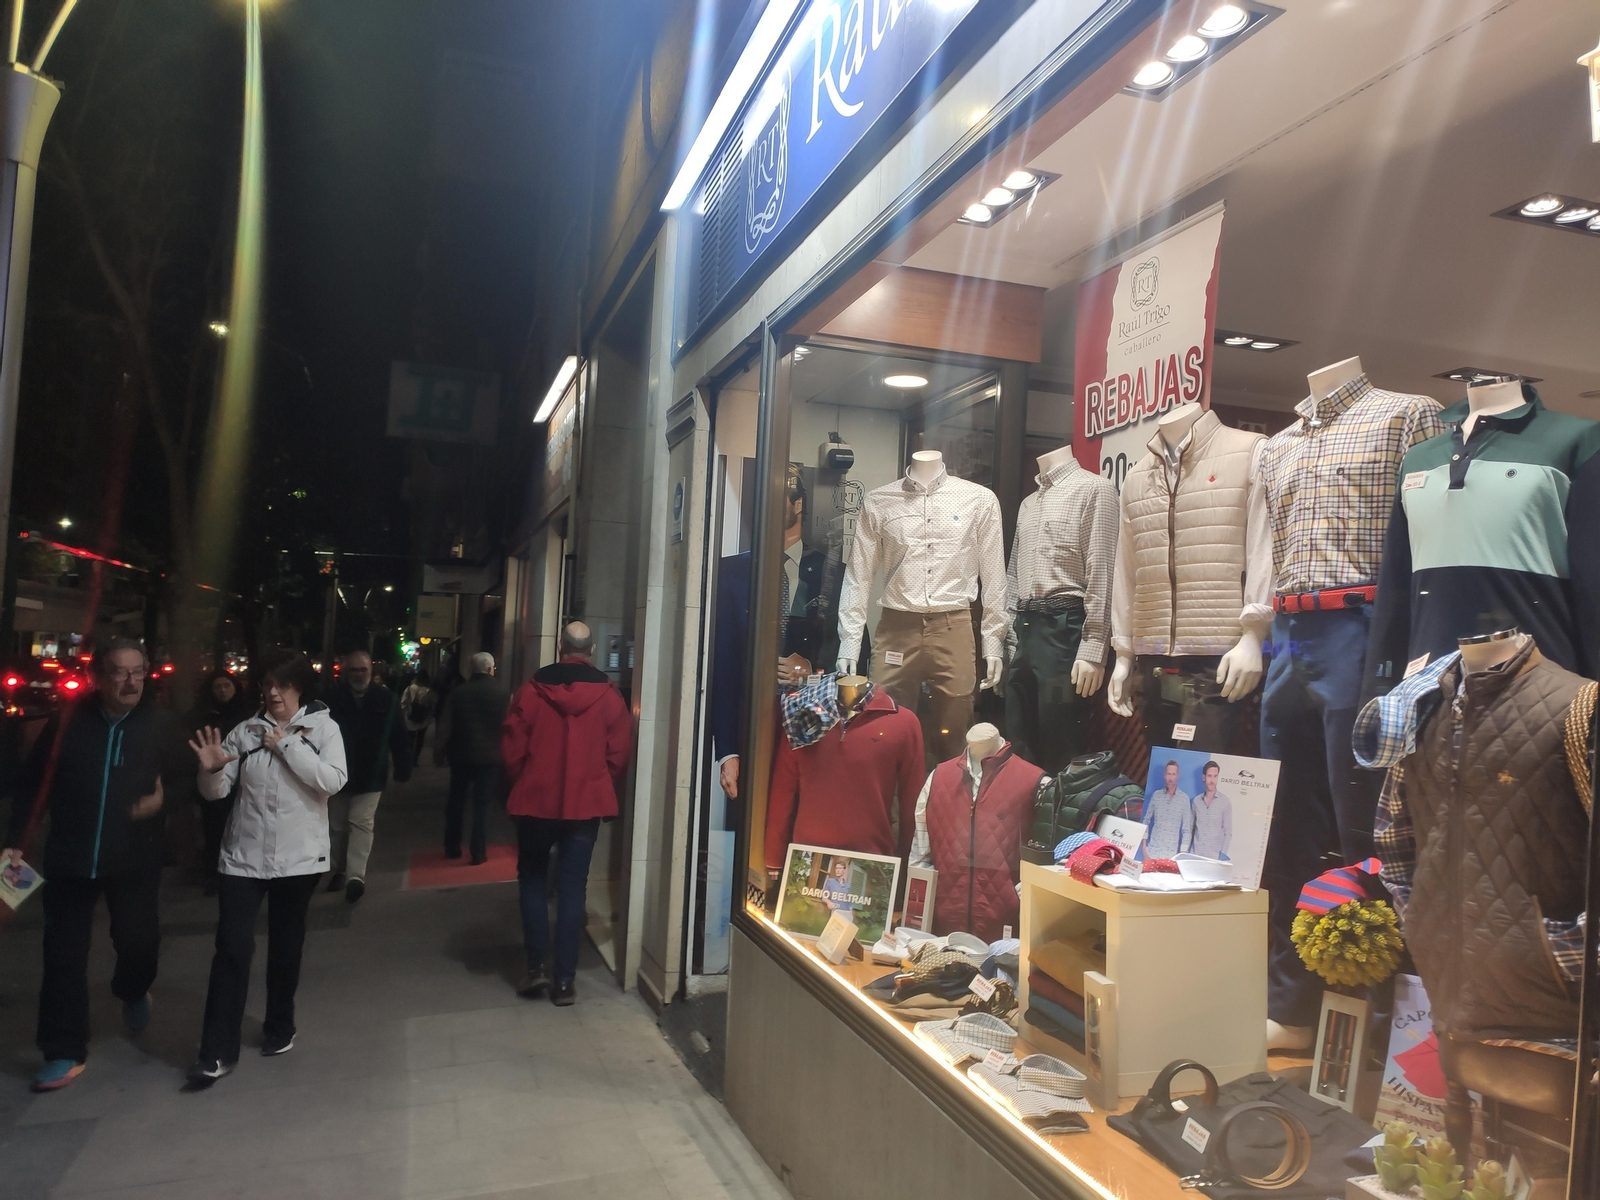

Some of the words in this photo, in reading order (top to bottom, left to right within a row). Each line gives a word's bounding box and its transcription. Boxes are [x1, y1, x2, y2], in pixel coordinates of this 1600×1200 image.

[756, 120, 779, 190] RT
[1138, 274, 1152, 294] RT
[1118, 313, 1141, 339] Raúl
[1143, 304, 1171, 324] Trigo
[1124, 333, 1162, 356] caballero
[1086, 345, 1202, 435] REBAJAS
[1102, 452, 1138, 496] 20
[1220, 777, 1240, 785] DARIO
[1240, 780, 1270, 789] BELTRAN
[801, 886, 830, 899] DARIO
[831, 891, 872, 906] BELTRAN
